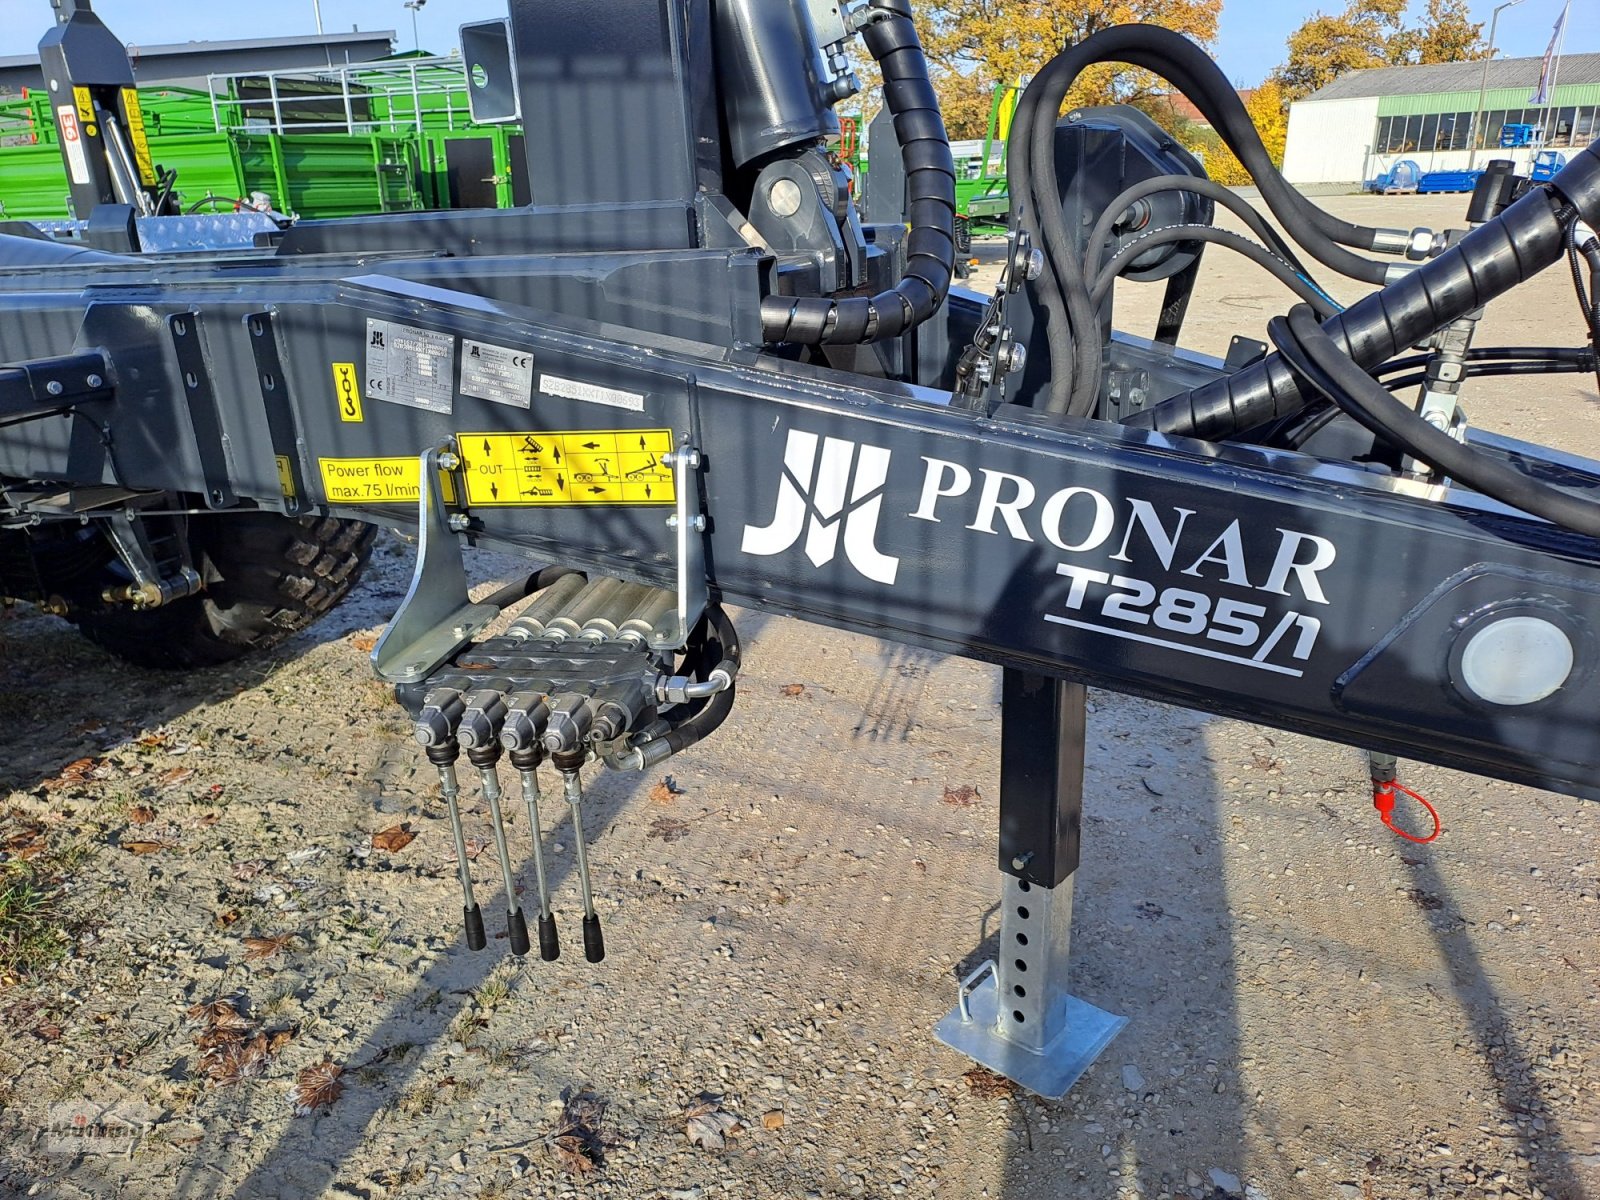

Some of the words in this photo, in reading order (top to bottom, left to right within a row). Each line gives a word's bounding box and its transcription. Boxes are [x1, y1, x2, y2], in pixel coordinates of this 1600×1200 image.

[327, 463, 370, 477] Power
[374, 463, 404, 476] flow
[479, 465, 503, 475] OUT
[908, 456, 1339, 605] PRONAR
[1055, 563, 1322, 660] T285/1
